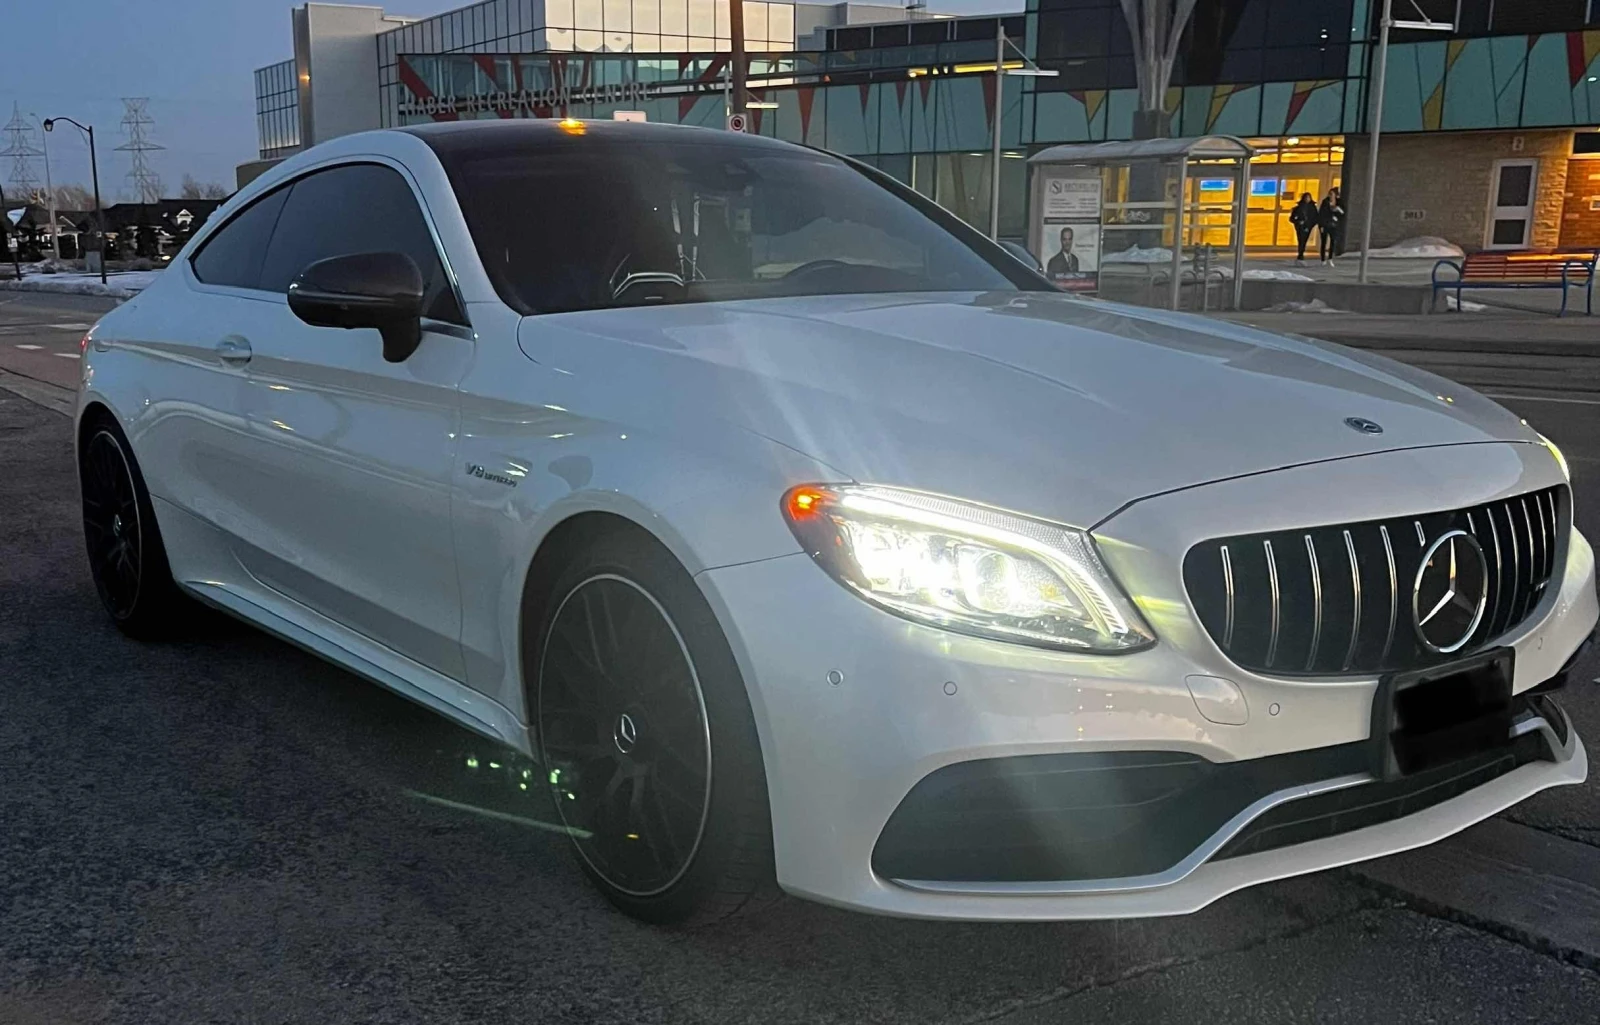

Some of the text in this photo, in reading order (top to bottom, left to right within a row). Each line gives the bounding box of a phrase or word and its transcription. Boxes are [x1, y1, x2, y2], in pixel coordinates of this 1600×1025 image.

[405, 81, 653, 116] HABER RECREATION CENTRE
[465, 462, 485, 478] V8
